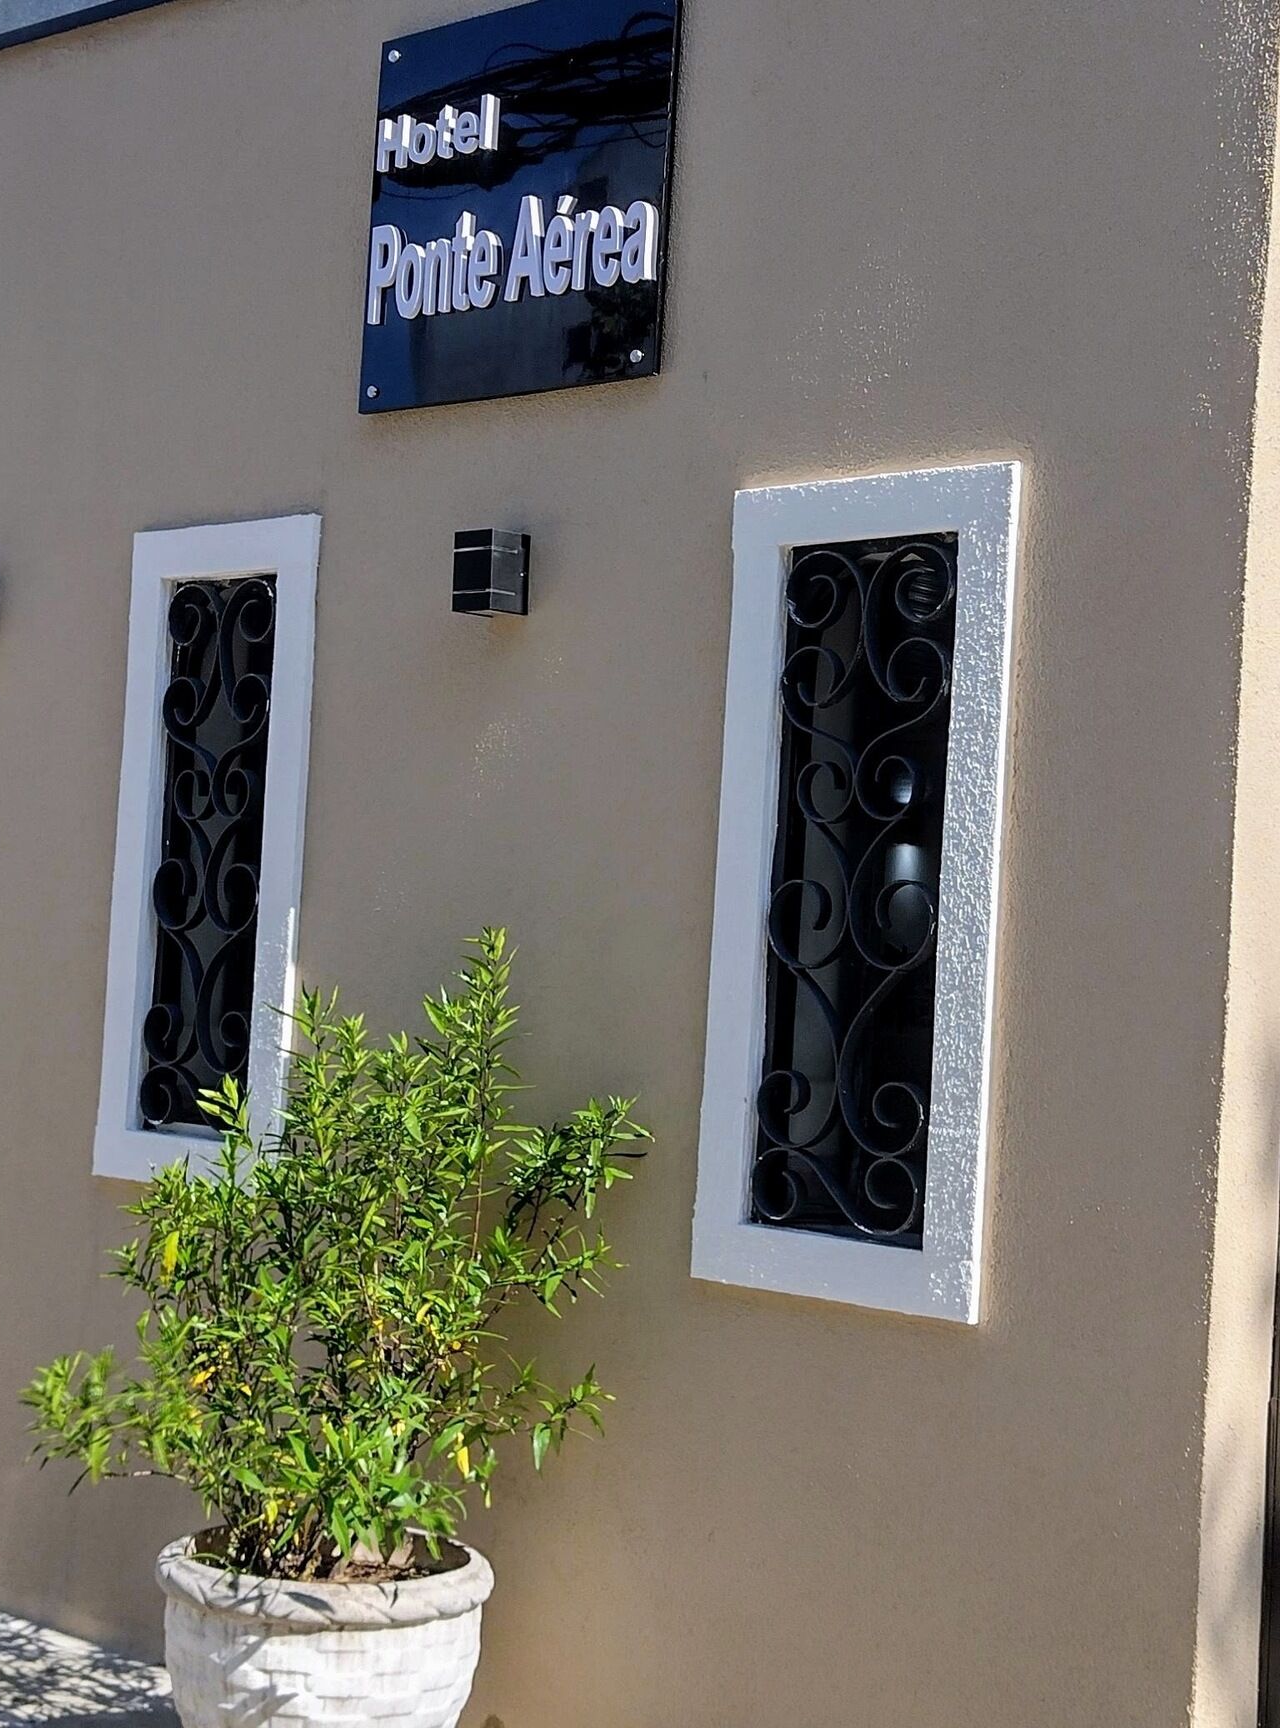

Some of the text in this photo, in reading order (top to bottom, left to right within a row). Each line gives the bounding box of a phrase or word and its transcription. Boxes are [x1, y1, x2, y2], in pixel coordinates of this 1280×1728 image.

[376, 93, 501, 172] Hotel
[367, 195, 659, 325] Ponte Aérea
